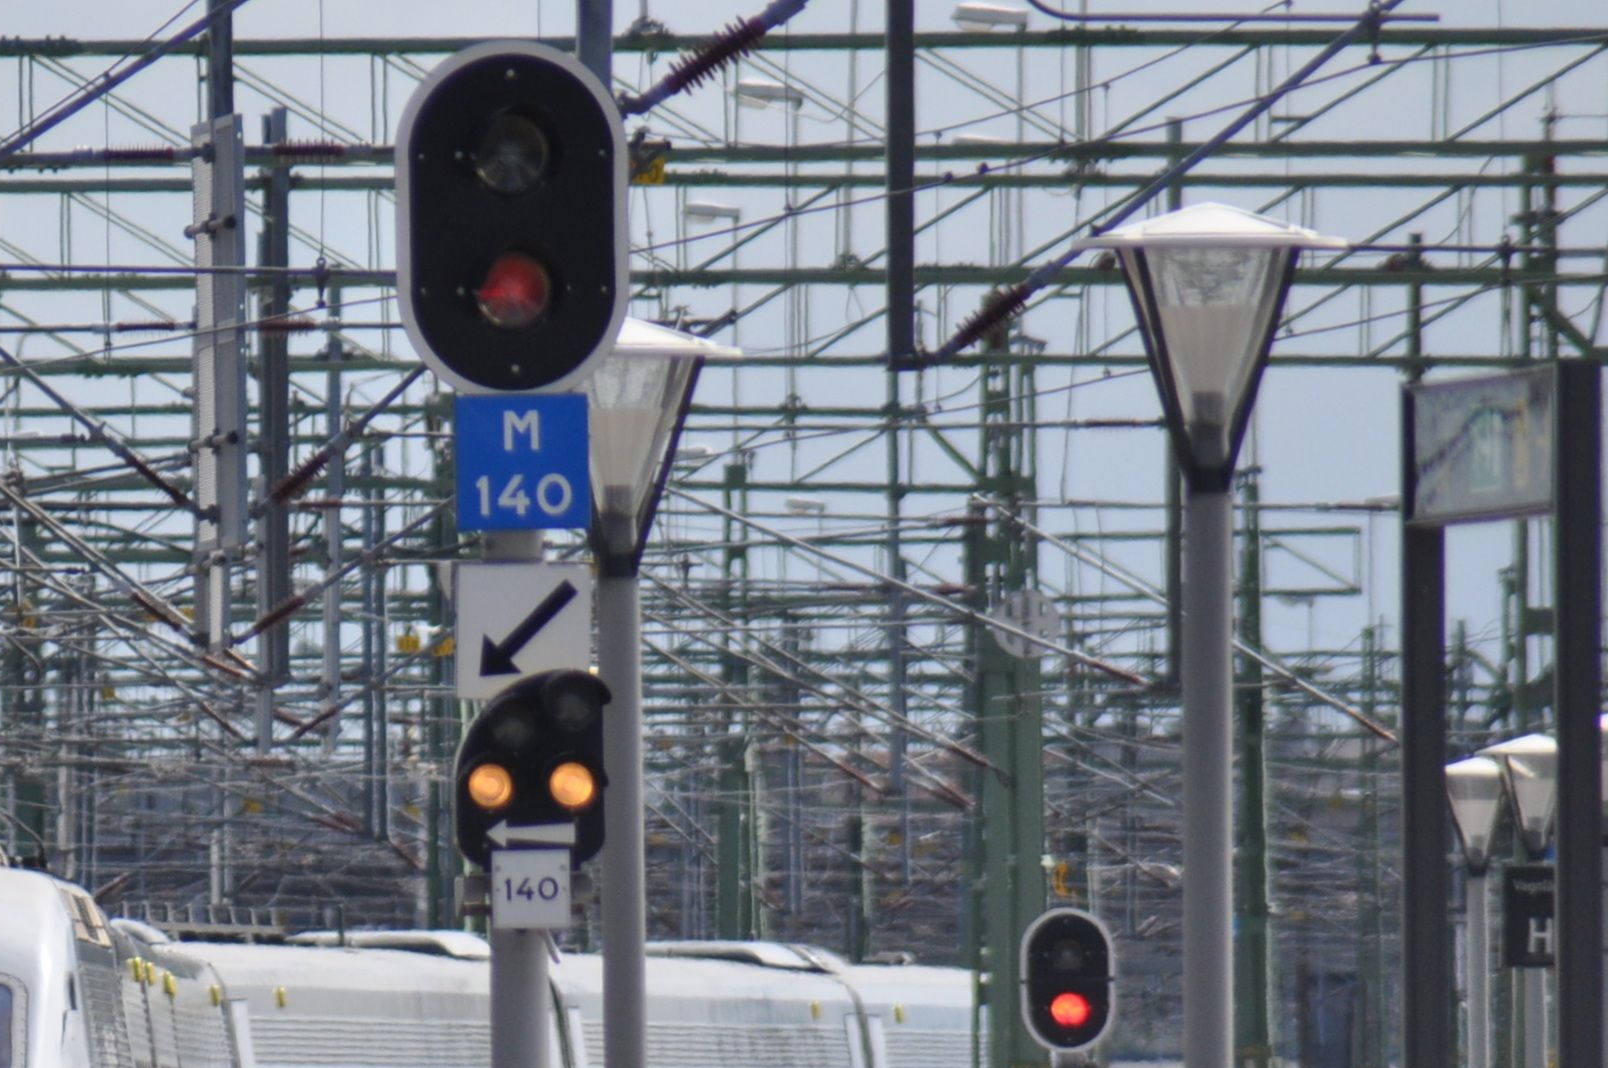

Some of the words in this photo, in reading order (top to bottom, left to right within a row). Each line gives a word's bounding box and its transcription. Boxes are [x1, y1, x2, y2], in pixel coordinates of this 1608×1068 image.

[503, 409, 539, 451] M
[475, 472, 572, 516] 140
[504, 876, 559, 901] 140
[1528, 918, 1553, 953] H
